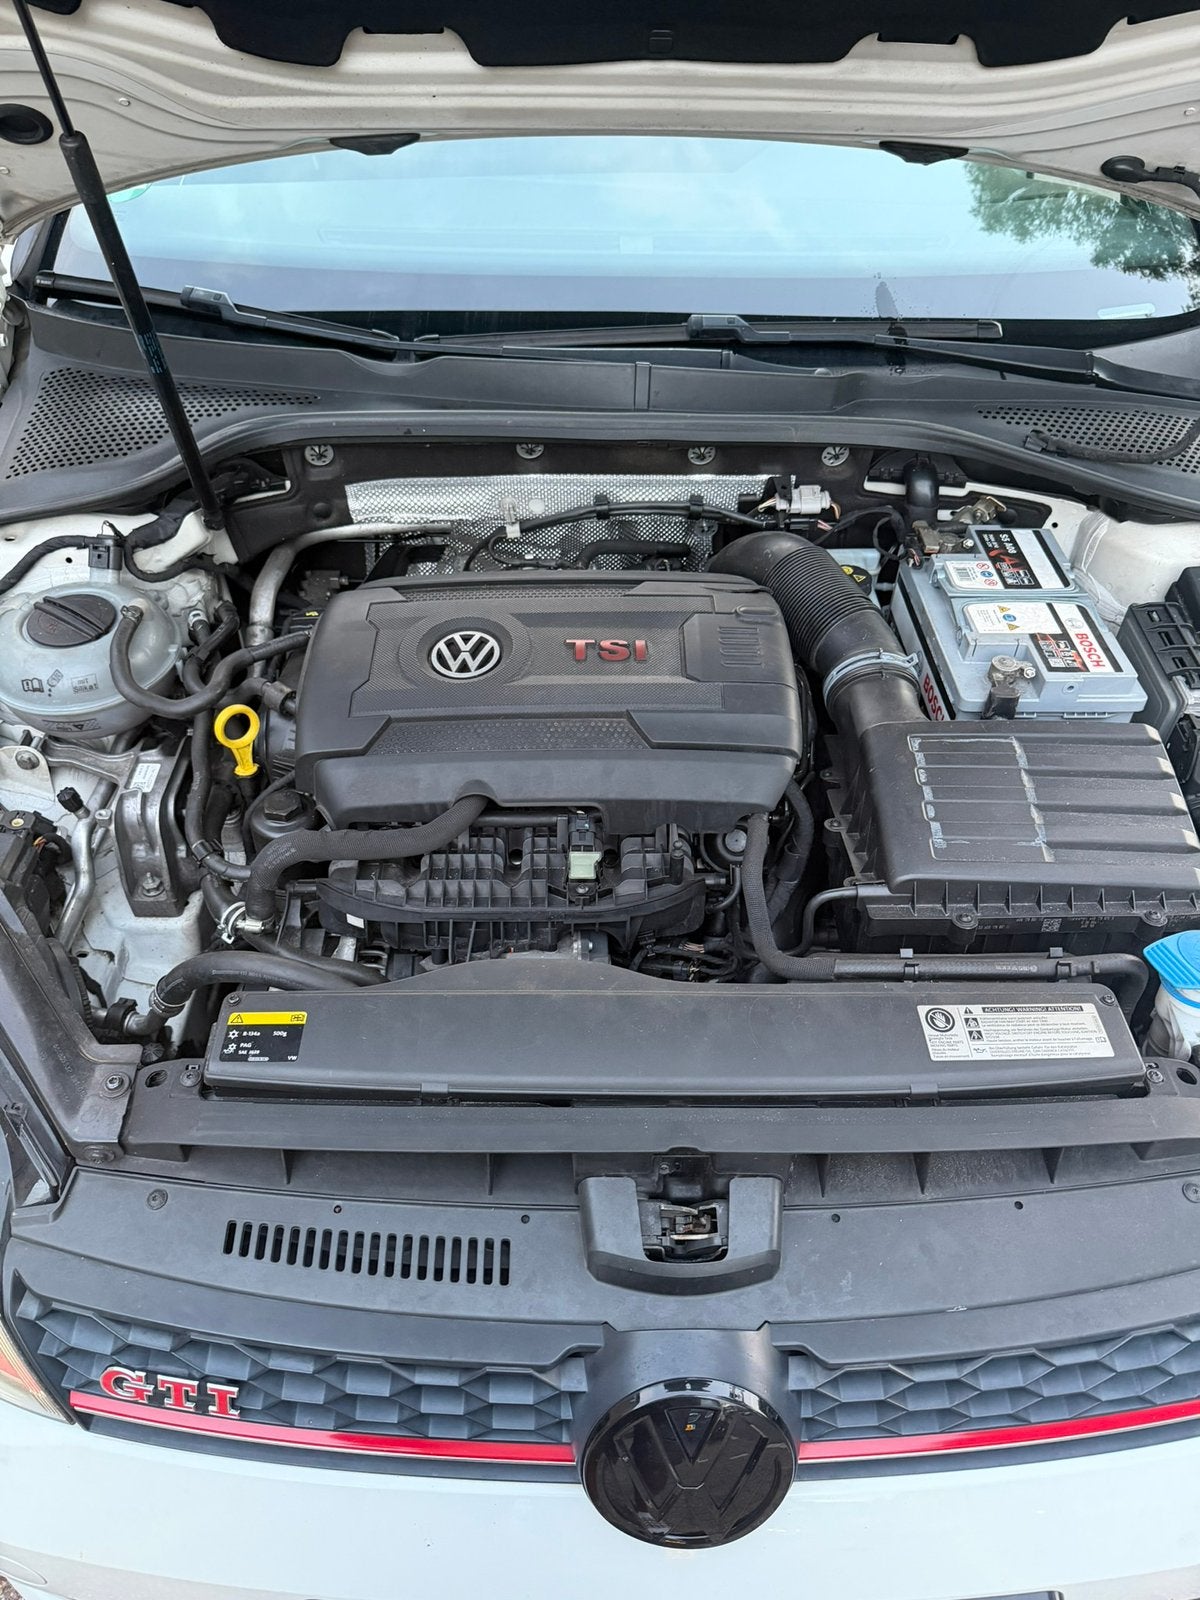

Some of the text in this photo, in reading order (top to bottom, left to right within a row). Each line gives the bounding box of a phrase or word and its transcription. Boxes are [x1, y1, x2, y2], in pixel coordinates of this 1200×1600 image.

[565, 638, 648, 662] TSI
[1075, 632, 1106, 668] BOSCH
[99, 1365, 242, 1419] GTI
